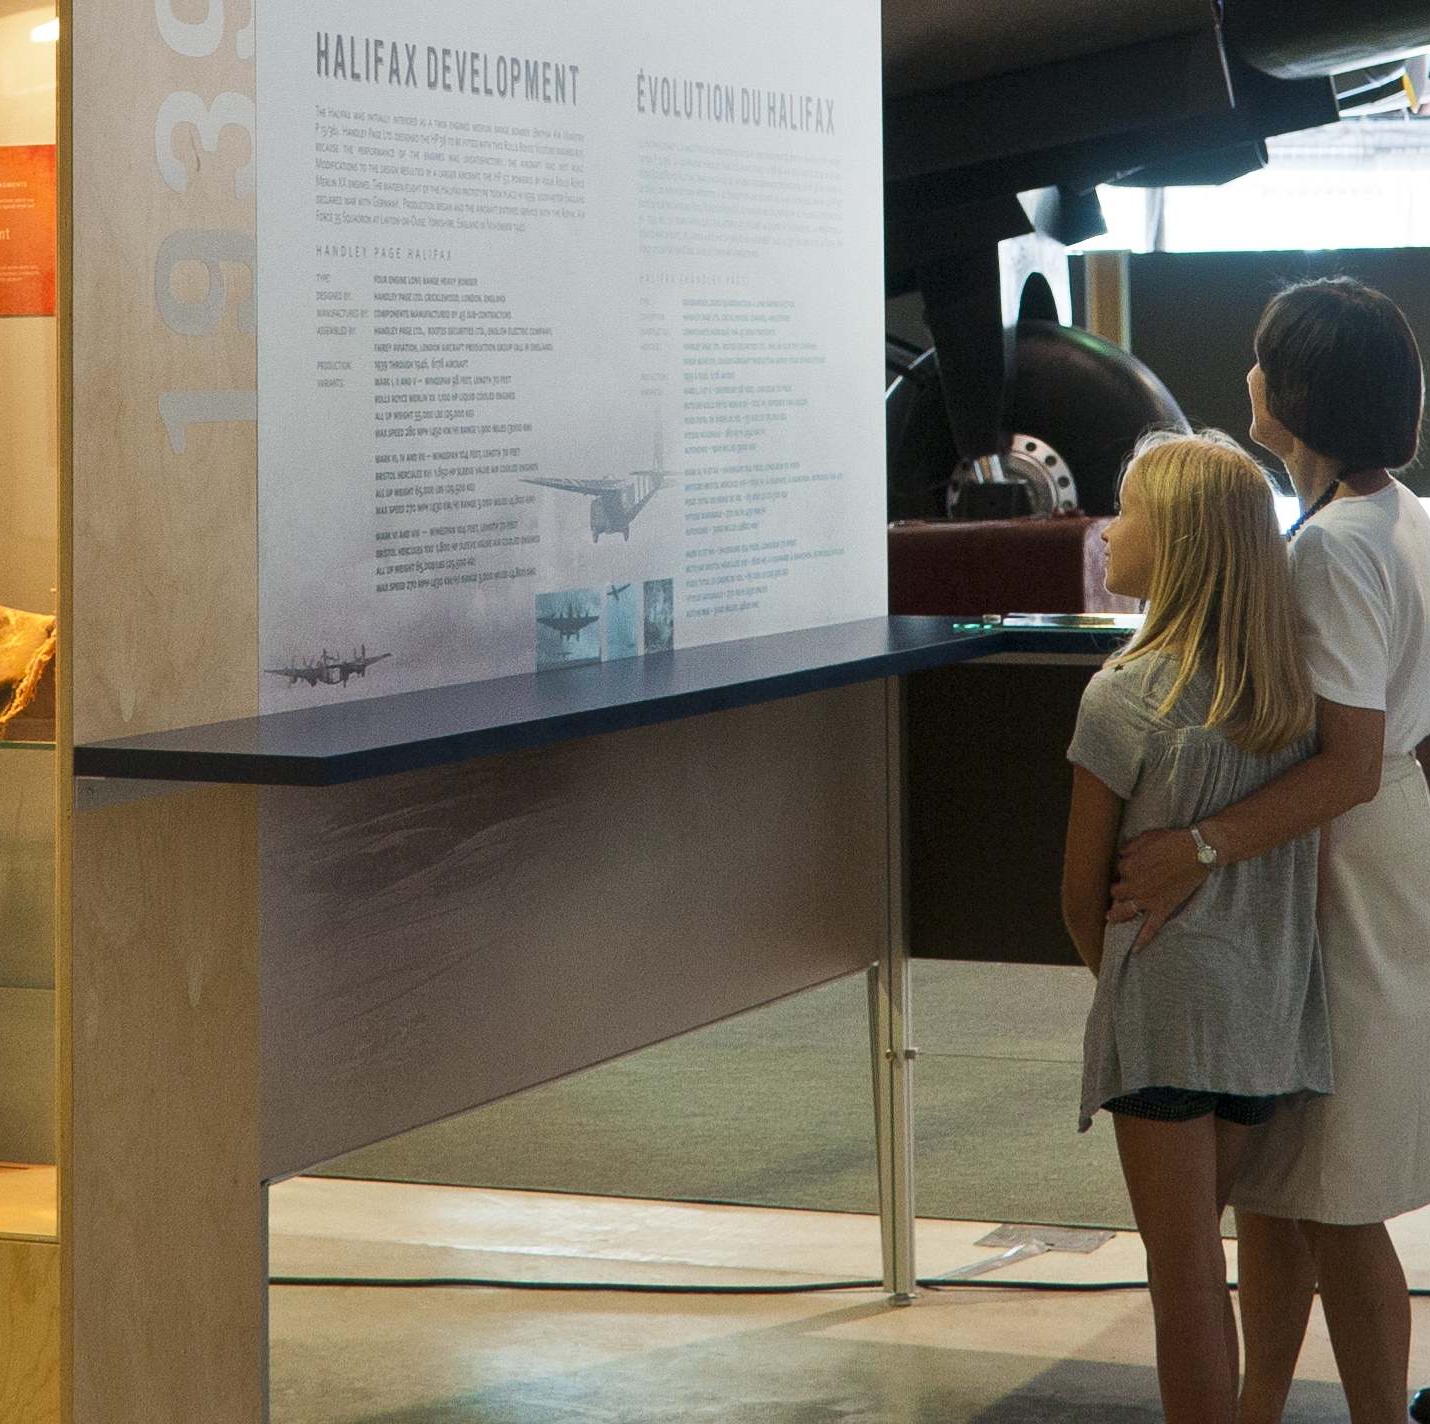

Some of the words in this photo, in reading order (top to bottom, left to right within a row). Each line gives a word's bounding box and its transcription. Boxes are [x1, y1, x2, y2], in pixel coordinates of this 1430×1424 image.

[316, 31, 416, 87] HALIFAX
[426, 46, 578, 106] DEVELOPMENT
[636, 68, 734, 123] ÉVOLUTION
[741, 87, 761, 126] DU
[767, 91, 834, 134] HALIFAX
[315, 244, 366, 258] HANDLEY
[374, 246, 400, 259] PAGE
[407, 247, 451, 260] HALIFAX
